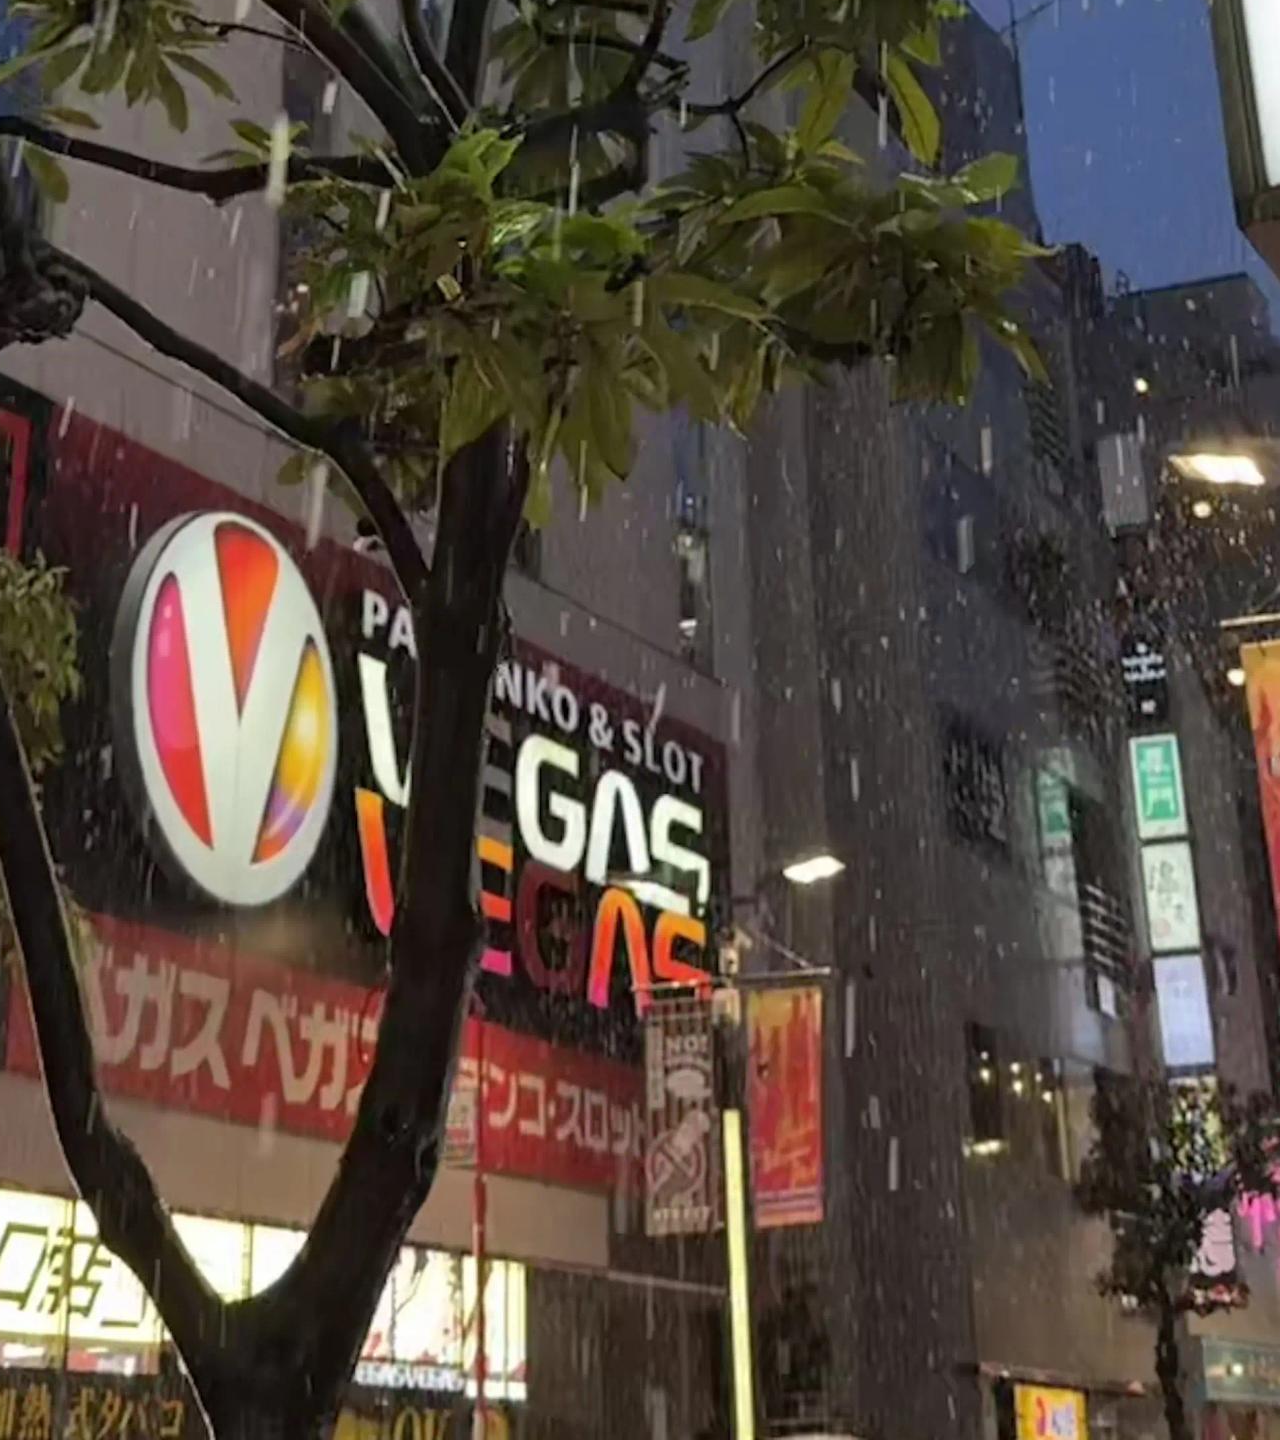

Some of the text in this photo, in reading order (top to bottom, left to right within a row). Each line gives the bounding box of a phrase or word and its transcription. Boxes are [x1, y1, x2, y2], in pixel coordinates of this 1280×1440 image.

[361, 588, 704, 796] PANKO & SLOT
